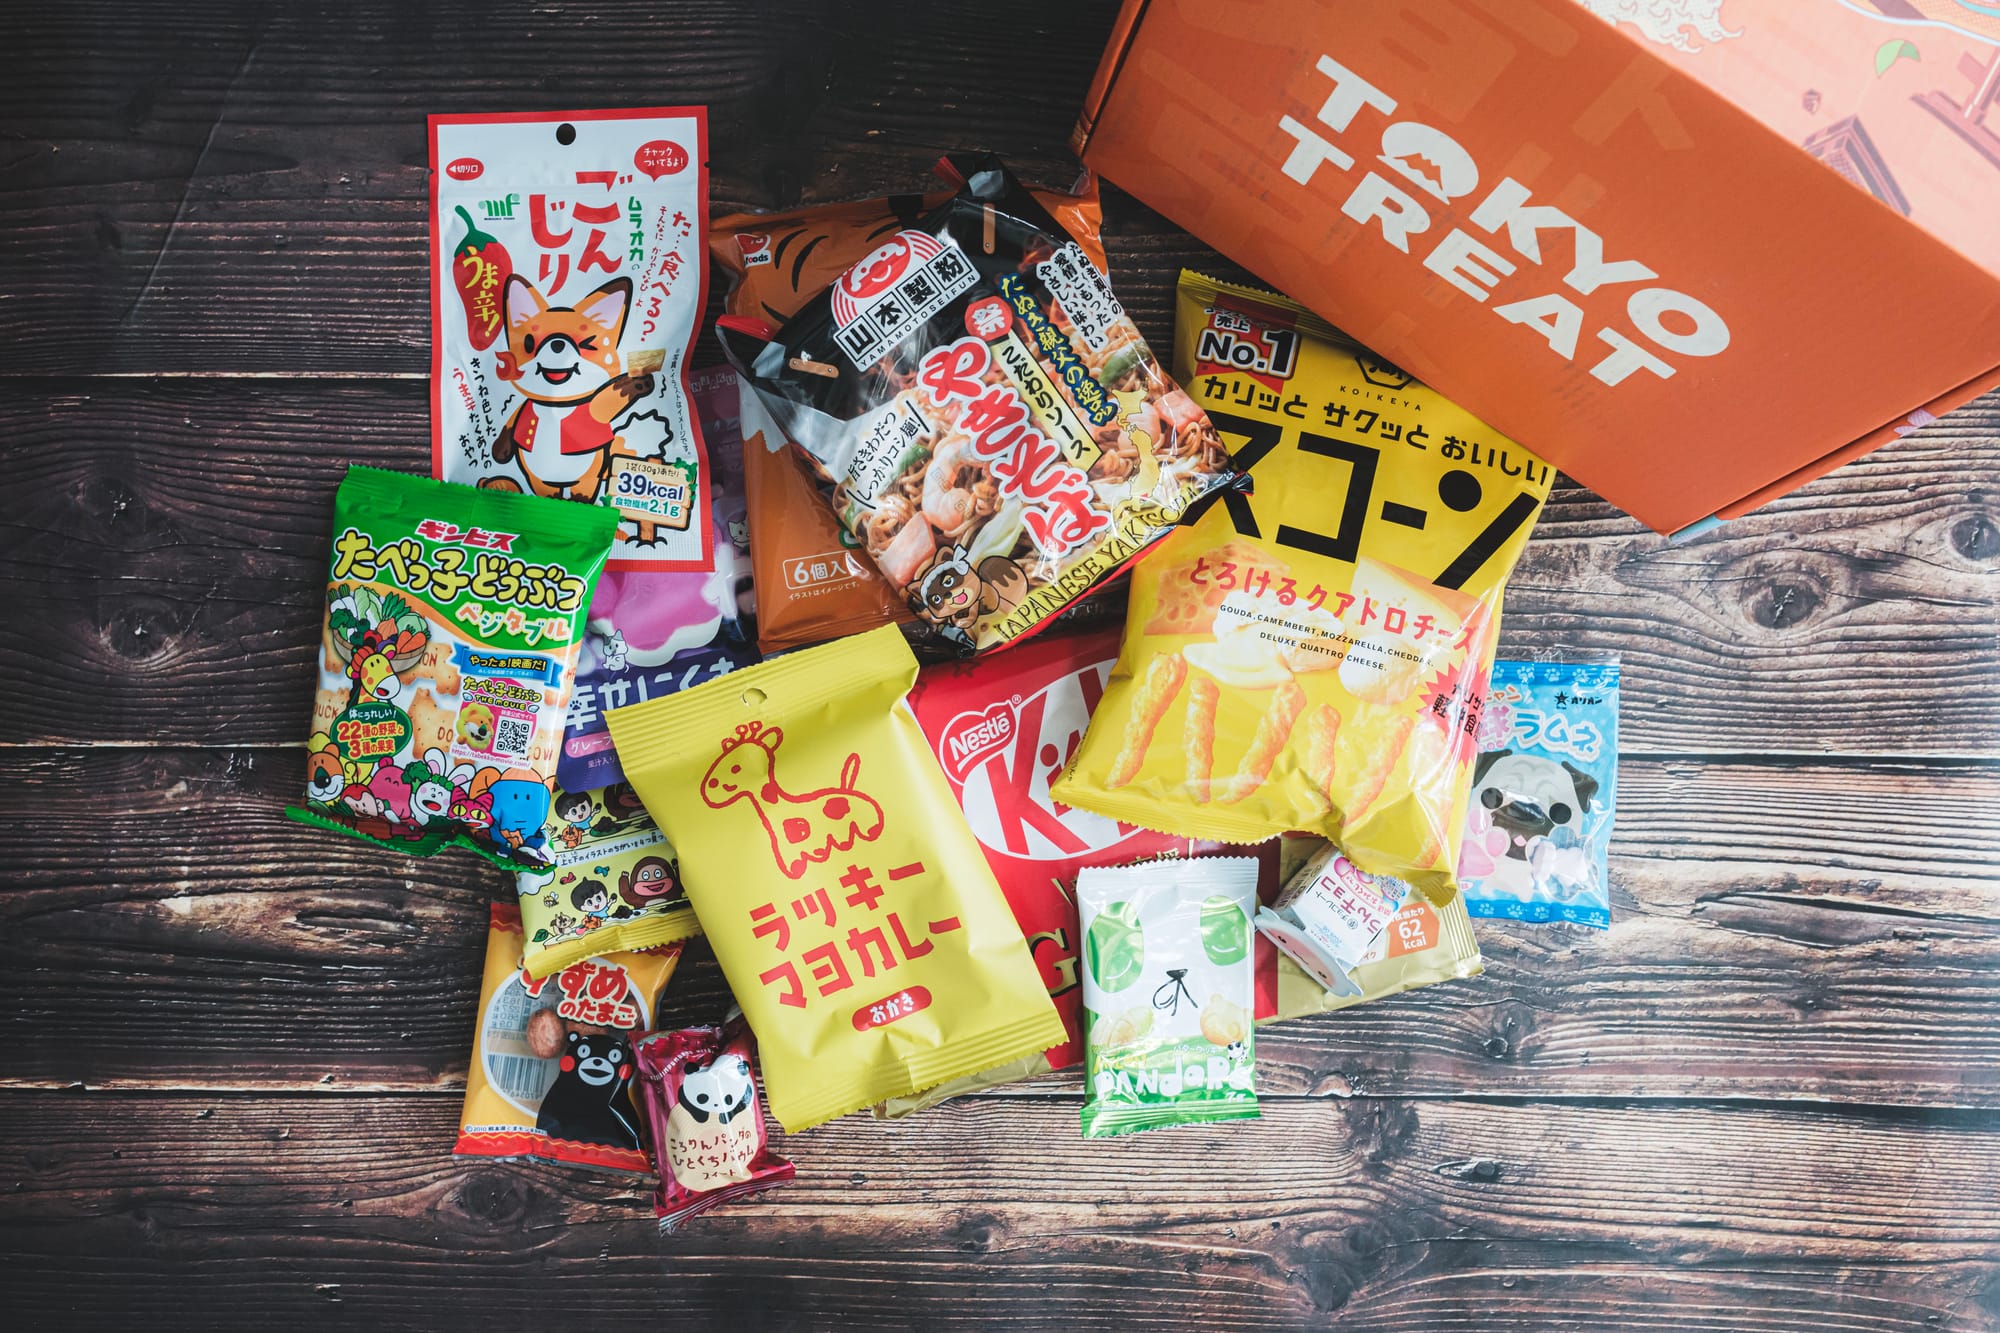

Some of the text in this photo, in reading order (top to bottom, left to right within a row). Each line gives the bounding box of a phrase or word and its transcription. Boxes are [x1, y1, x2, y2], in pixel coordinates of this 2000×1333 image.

[643, 147, 673, 157] チャック
[456, 164, 478, 174] 切り口
[1316, 55, 1730, 357] TOKYO
[628, 196, 644, 271] ムラオカの
[1279, 114, 1676, 387] TREAT
[842, 251, 966, 355] 山本製粉
[1039, 264, 1104, 348] やさしい味わい
[861, 275, 976, 368] YAMAMOTOSEIFUN
[1215, 314, 1251, 332] 売上
[1200, 330, 1296, 374] No.1
[470, 357, 498, 437] きつね色した
[1002, 345, 1091, 460] こだわりソース
[1204, 376, 1308, 419] カリッと
[1323, 402, 1430, 450] サクッと
[1339, 385, 1422, 412] KOIKEYA
[920, 340, 1108, 553] やきそば
[617, 472, 684, 501] 39kcal
[416, 520, 521, 552] ギンビス
[333, 528, 586, 611] たべっ子どうぶつ
[793, 556, 855, 585] 6個入
[456, 602, 571, 646] ベジタブル
[1259, 631, 1297, 648] DELUXE
[1300, 642, 1345, 660] QUATTRO
[462, 676, 542, 703] たべっ子どうぶつ
[475, 694, 494, 705] THE
[337, 720, 405, 742] 22種の野菜と
[348, 708, 398, 721] 体にうれしい!
[1398, 918, 1425, 940] 62
[1402, 934, 1427, 951] kcal
[759, 912, 962, 1009] マヨカレー
[559, 998, 635, 1026] のたまご
[869, 991, 916, 1025] おかき
